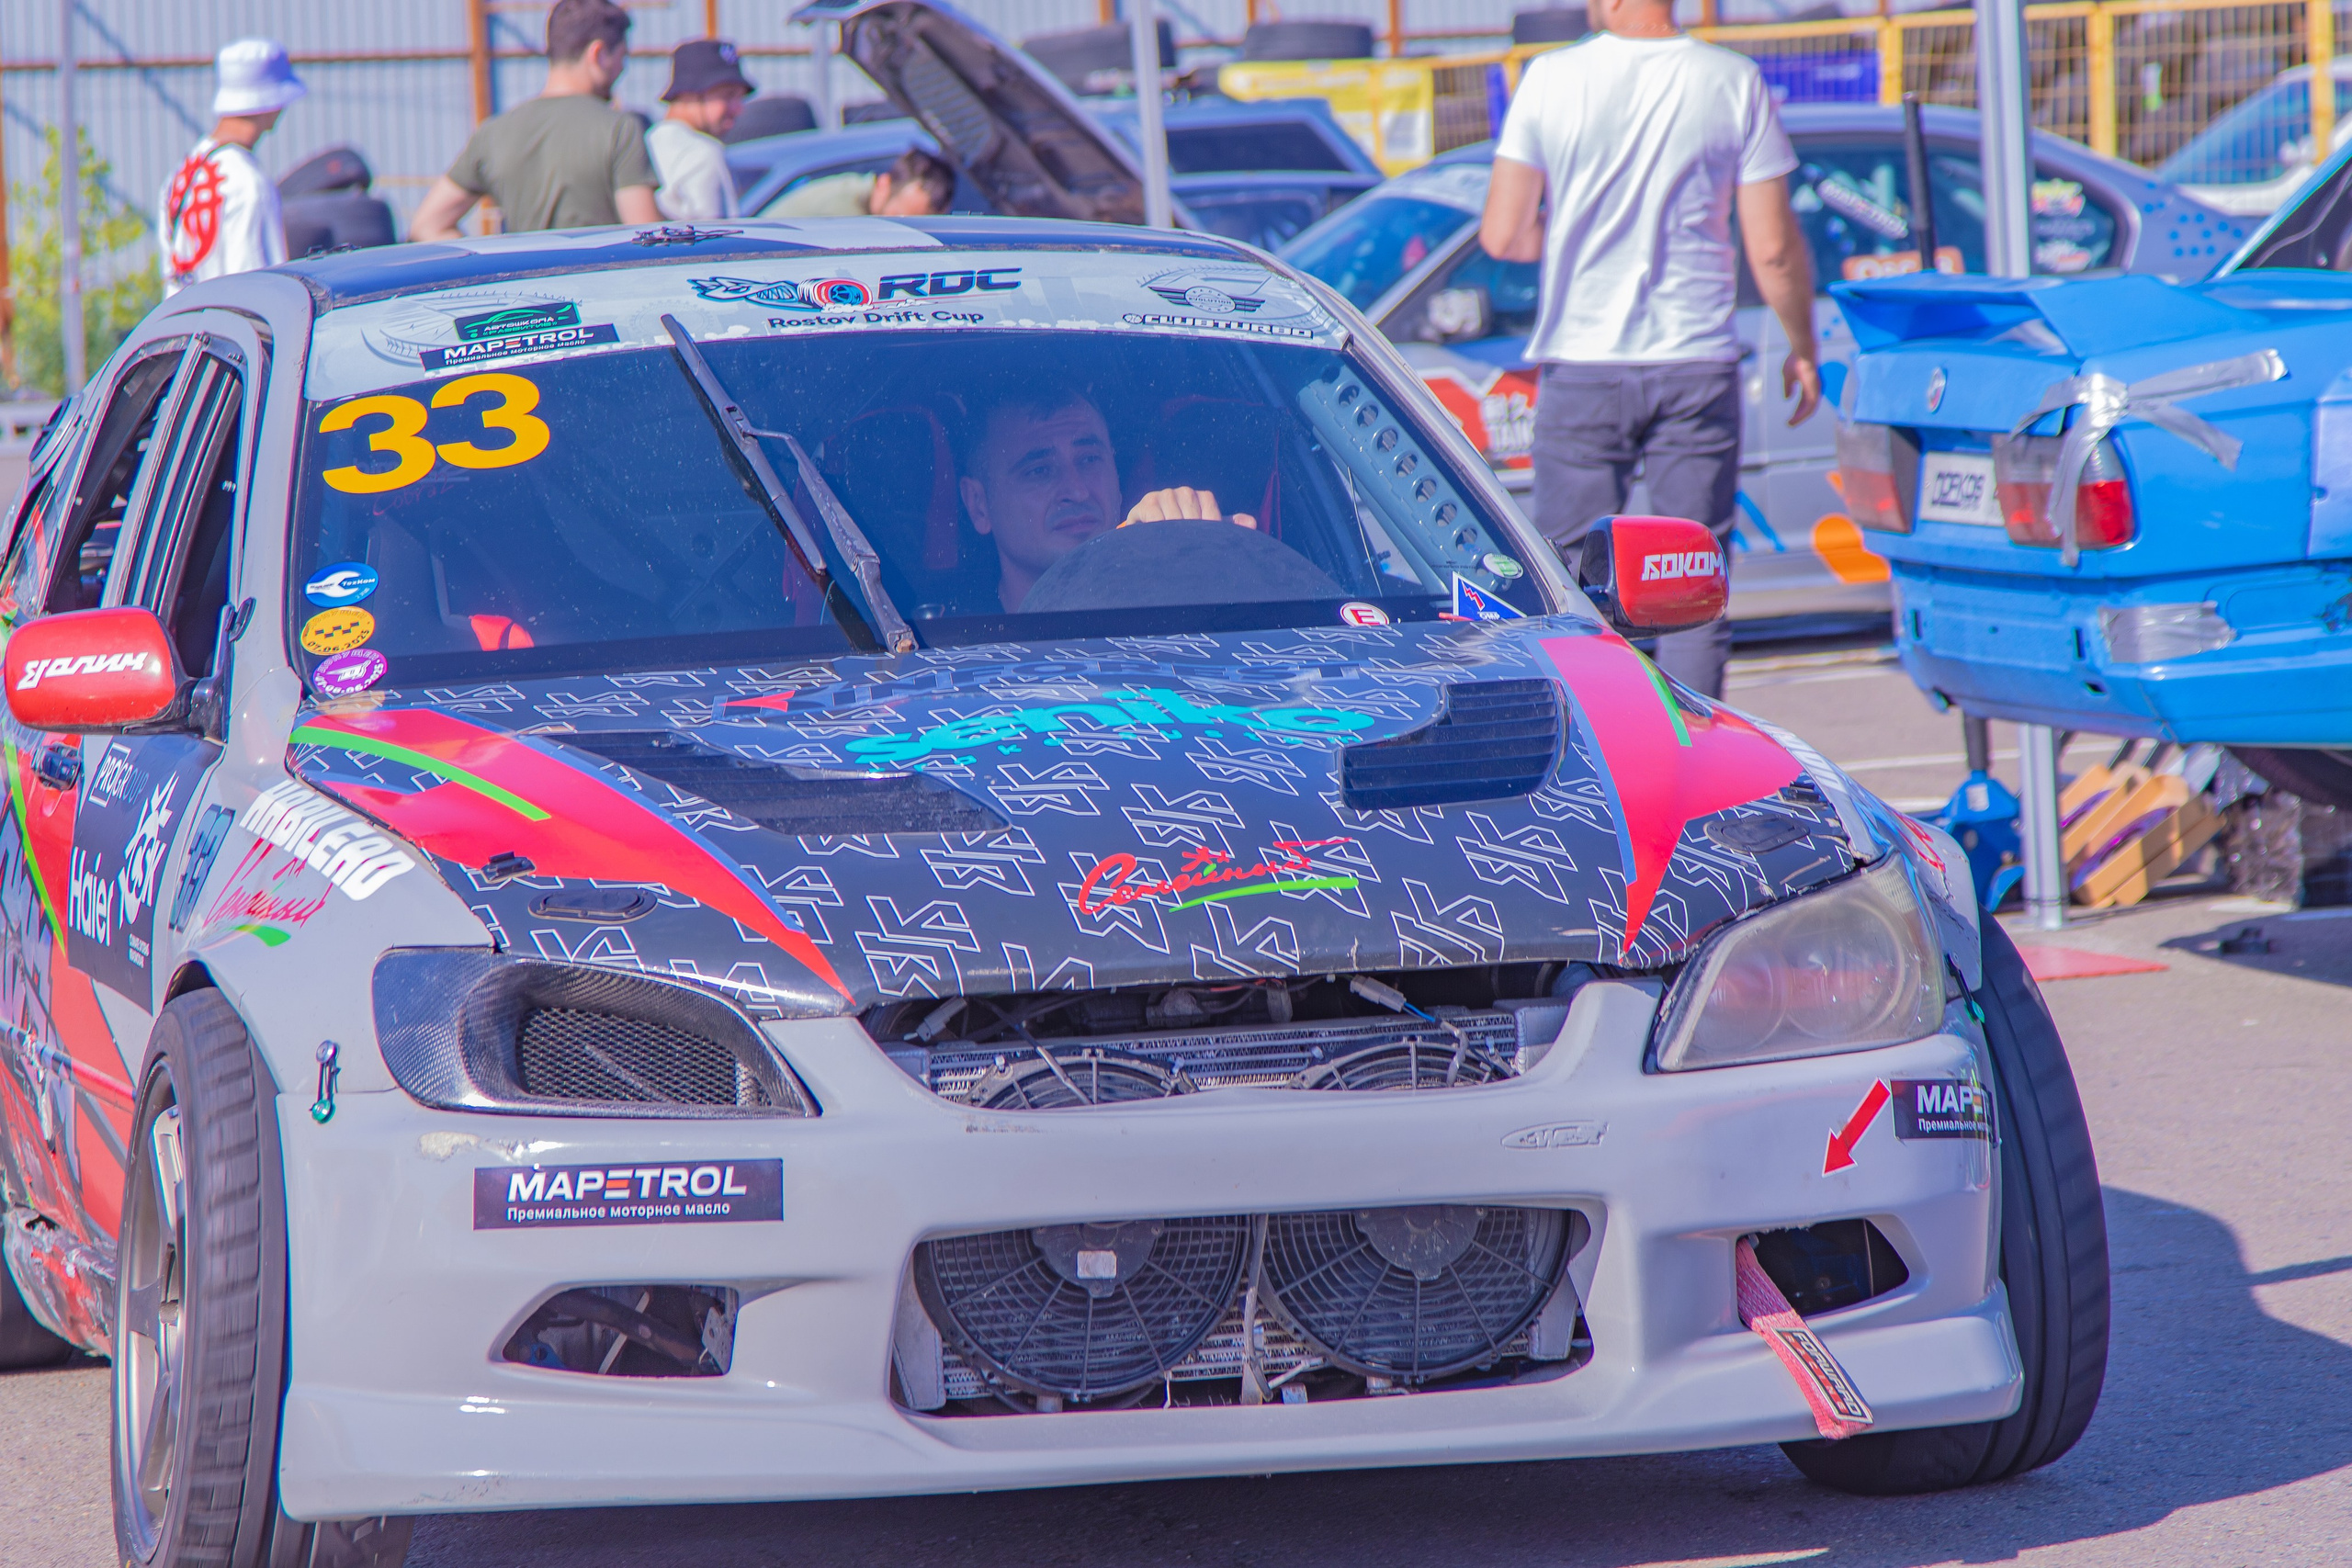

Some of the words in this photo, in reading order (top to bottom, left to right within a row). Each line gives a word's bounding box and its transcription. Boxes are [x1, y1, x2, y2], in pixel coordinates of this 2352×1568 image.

[877, 267, 1023, 299] RDC
[767, 315, 855, 329] Rostov
[864, 310, 926, 323] Drift
[932, 310, 985, 323] Cup
[1143, 313, 1314, 339] CLUBTURBO
[444, 331, 594, 360] MAPETROL
[446, 350, 508, 366] Премиальное
[511, 344, 555, 355] моторное
[558, 339, 586, 349] масло
[319, 373, 550, 494] 33
[845, 688, 1375, 764] seniko
[68, 846, 116, 947] Haier
[507, 1166, 748, 1203] MAPETROL
[506, 1205, 606, 1224] Премиальное
[609, 1202, 681, 1221] моторное
[684, 1202, 730, 1216] масло
[1792, 1332, 1862, 1416] FORWARD
